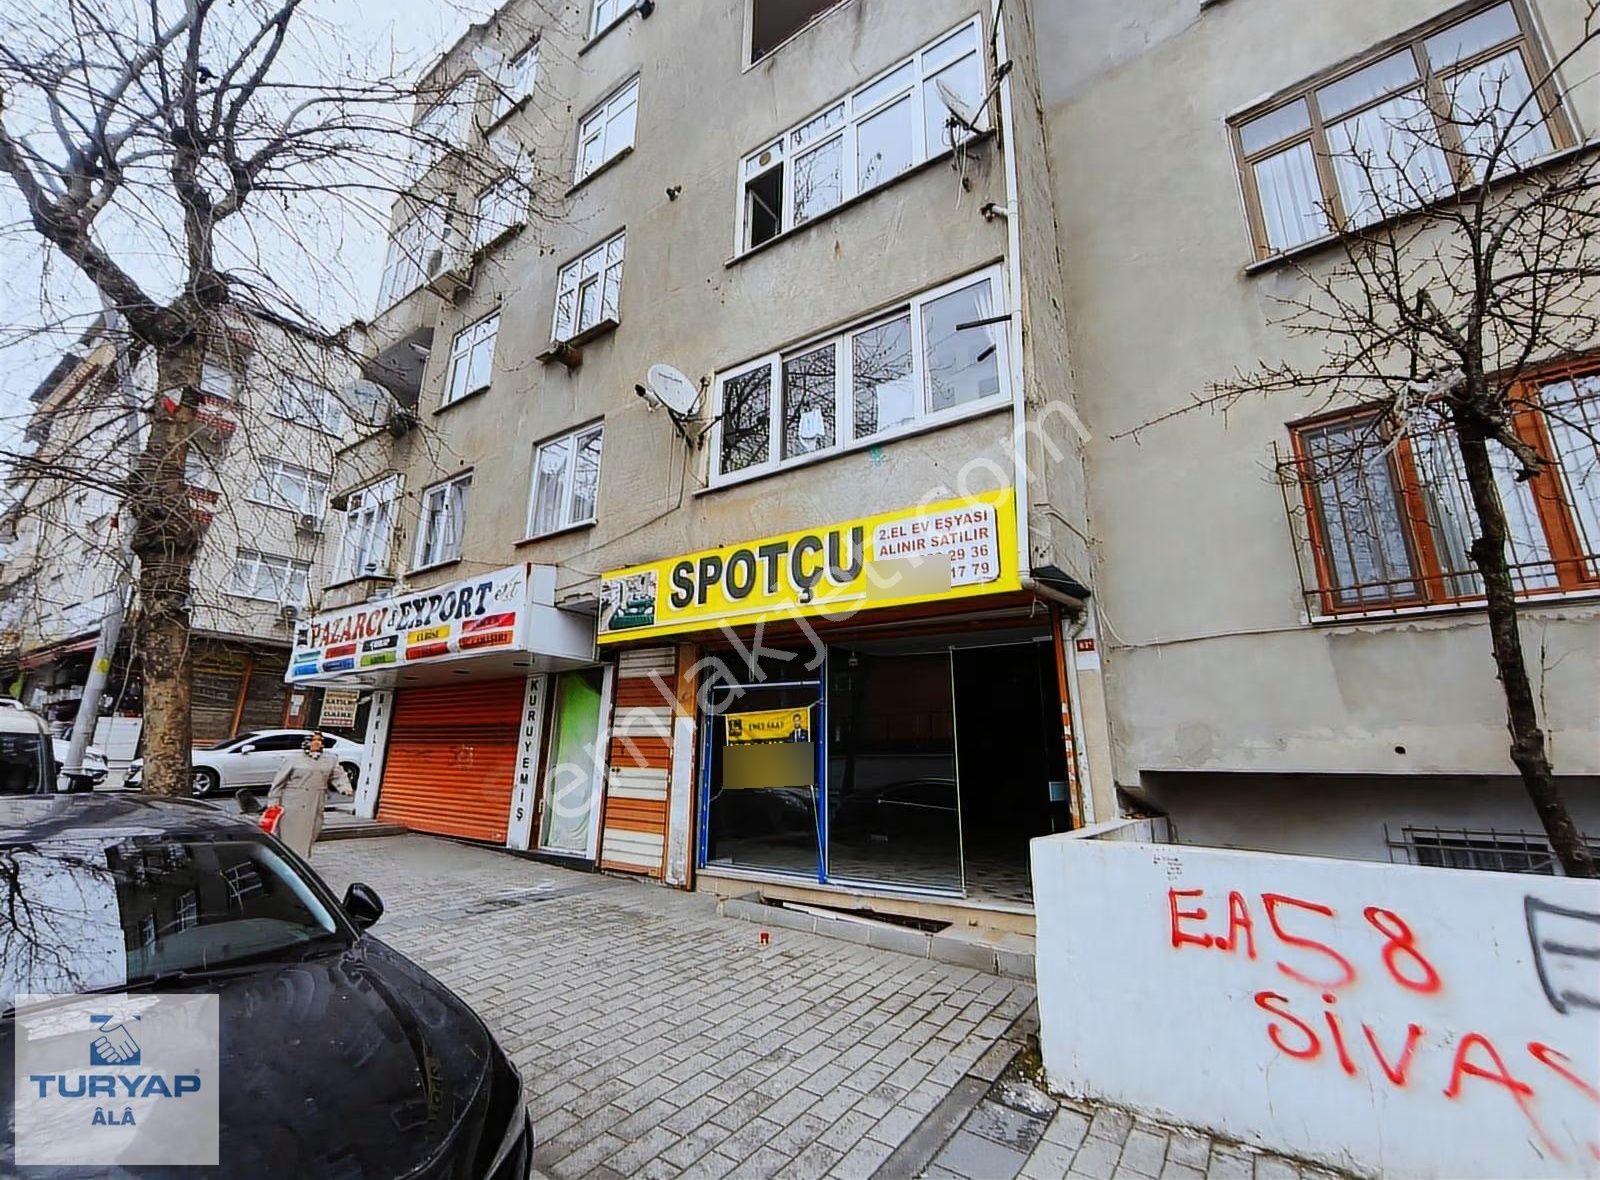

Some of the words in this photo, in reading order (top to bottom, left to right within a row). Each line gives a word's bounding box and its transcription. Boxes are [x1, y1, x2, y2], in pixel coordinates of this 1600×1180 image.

[879, 526, 907, 540] 2.EL
[911, 520, 930, 534] EV
[935, 510, 988, 531] EŞYASI
[880, 538, 926, 556] ALINIR
[971, 544, 989, 558] 36
[669, 526, 864, 608] SPOTÇU
[972, 562, 990, 576] 79
[310, 607, 388, 648] PAZARCI
[396, 581, 493, 631] EXPORT
[516, 679, 539, 822] KURUYEMİŞ
